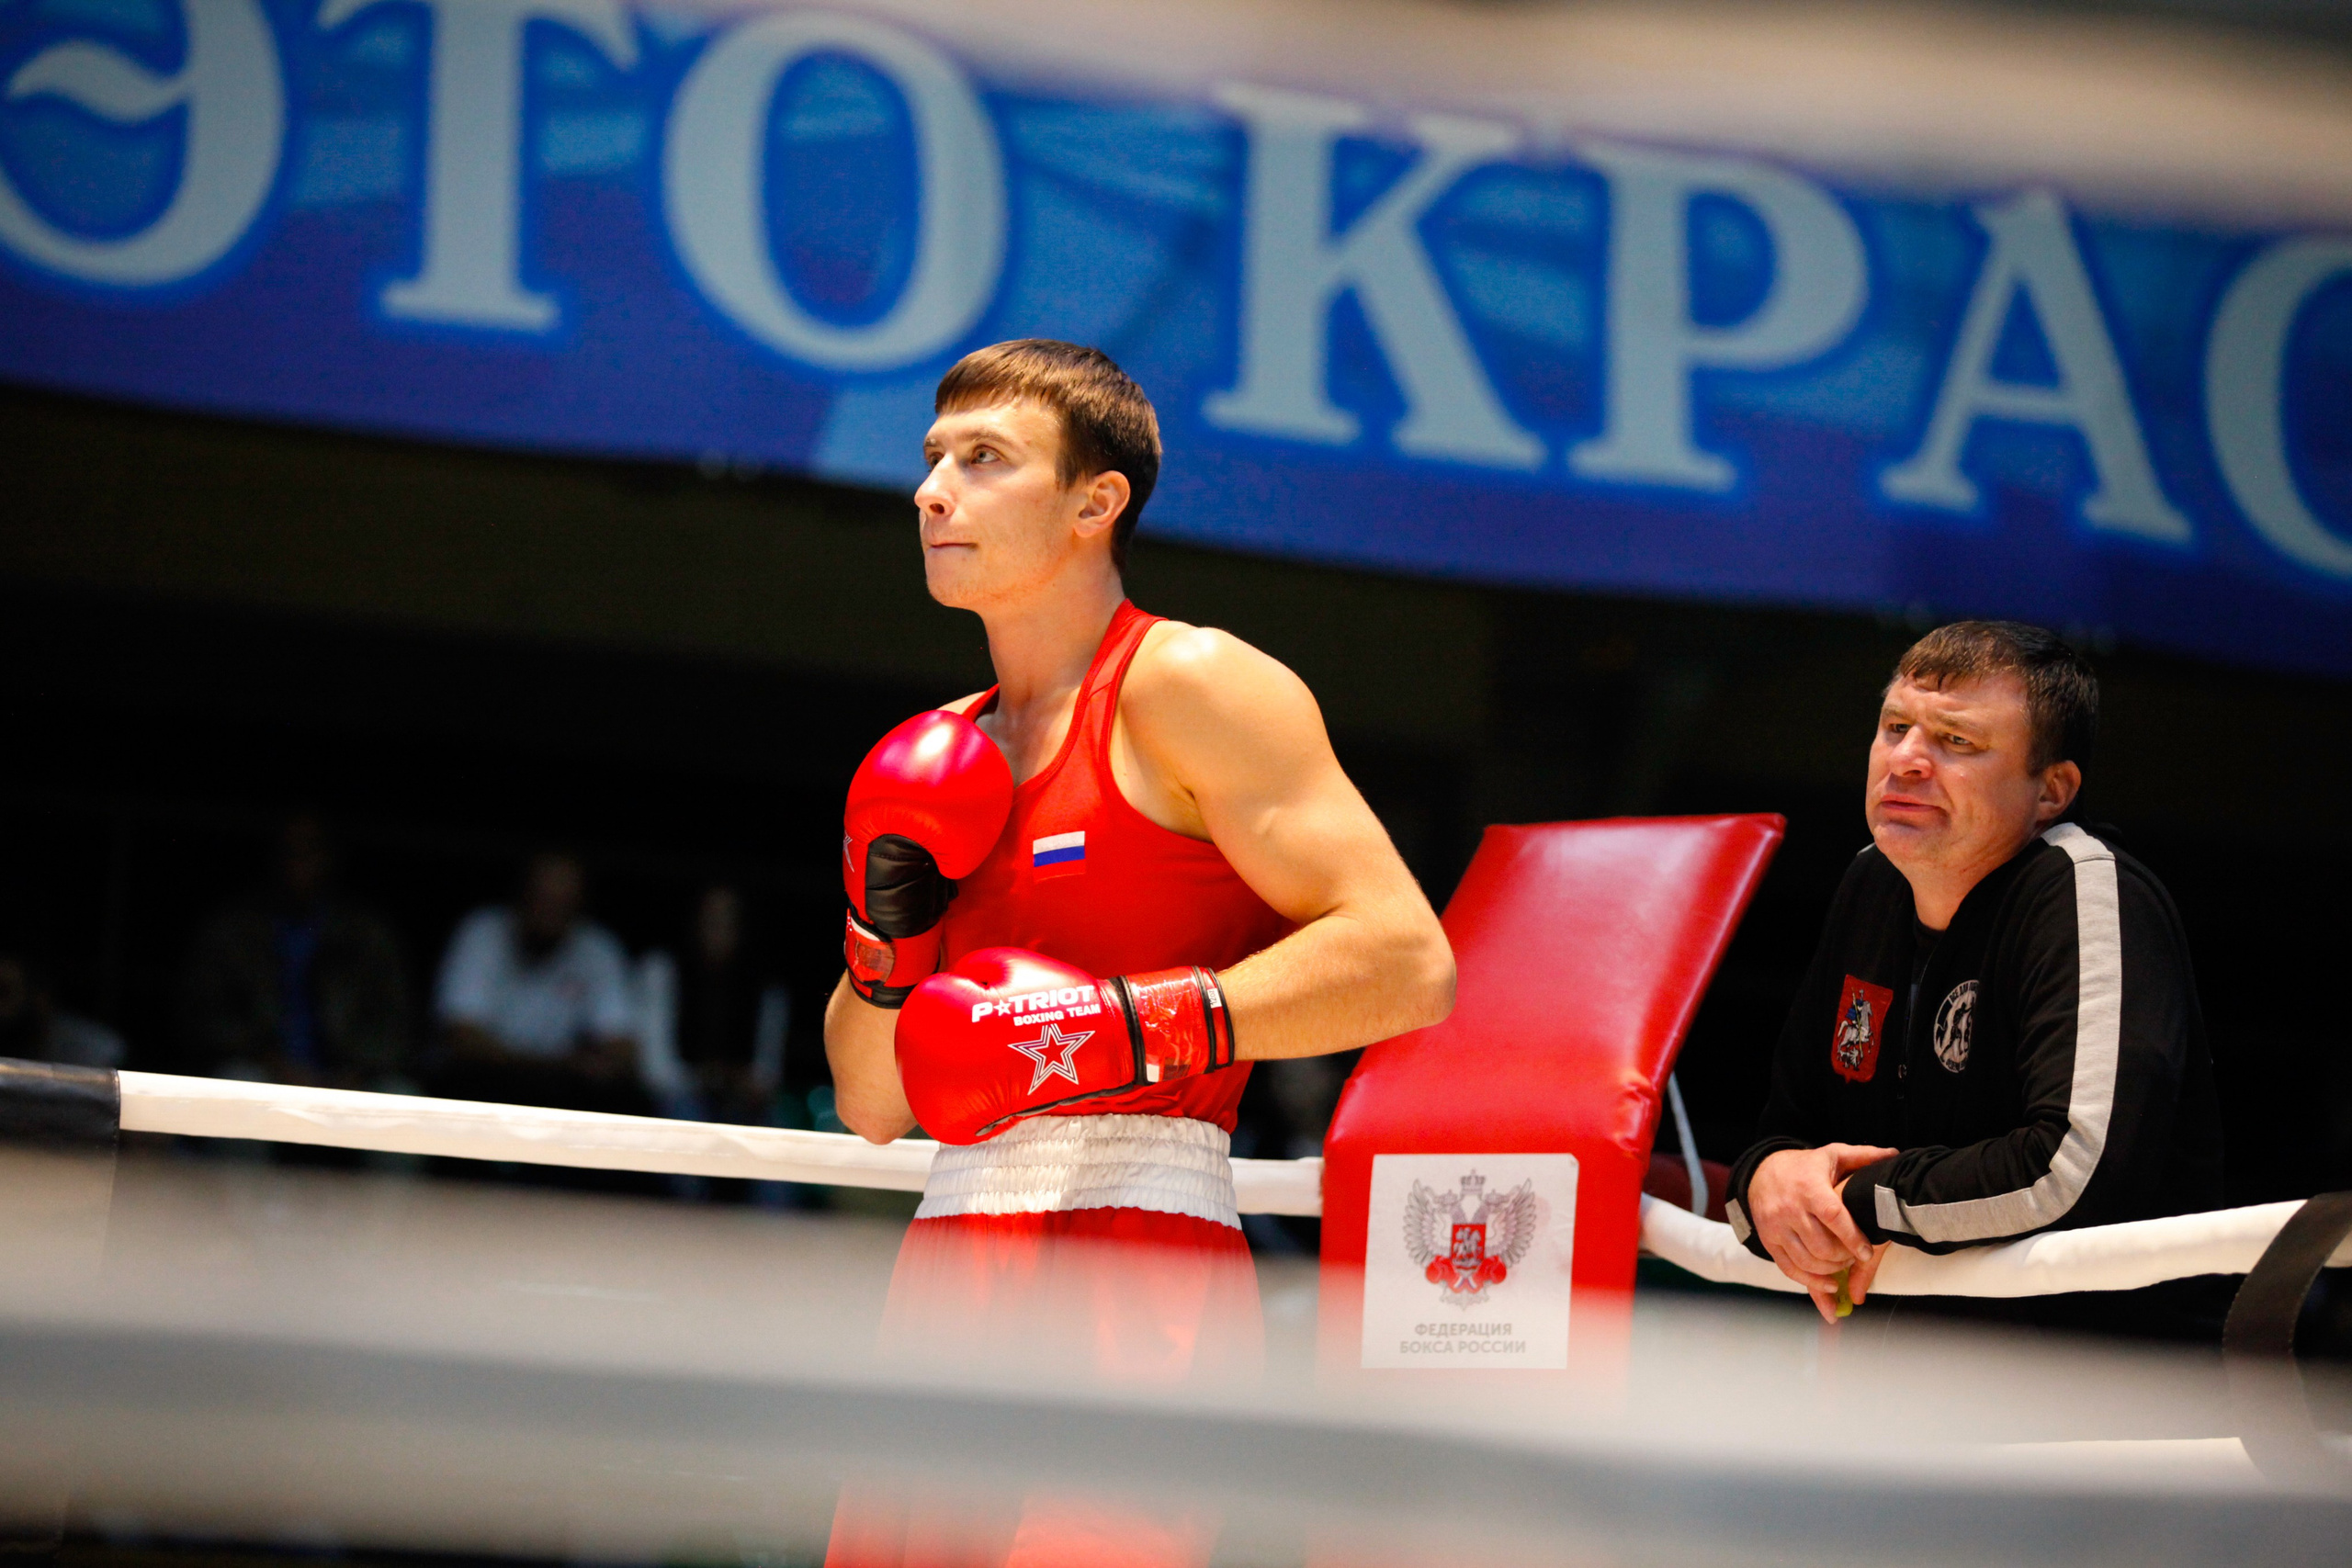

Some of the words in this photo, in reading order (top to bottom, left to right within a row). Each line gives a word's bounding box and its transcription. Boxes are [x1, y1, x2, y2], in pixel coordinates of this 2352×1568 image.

[0, 0, 1009, 369] ЭТО
[1013, 1011, 1065, 1026] BOXING
[1067, 1003, 1101, 1017] TEAM
[1414, 1323, 1512, 1337] ФЕДЕРАЦИЯ
[1399, 1340, 1453, 1353] БОКСА
[1458, 1340, 1526, 1353] РОССИИ
